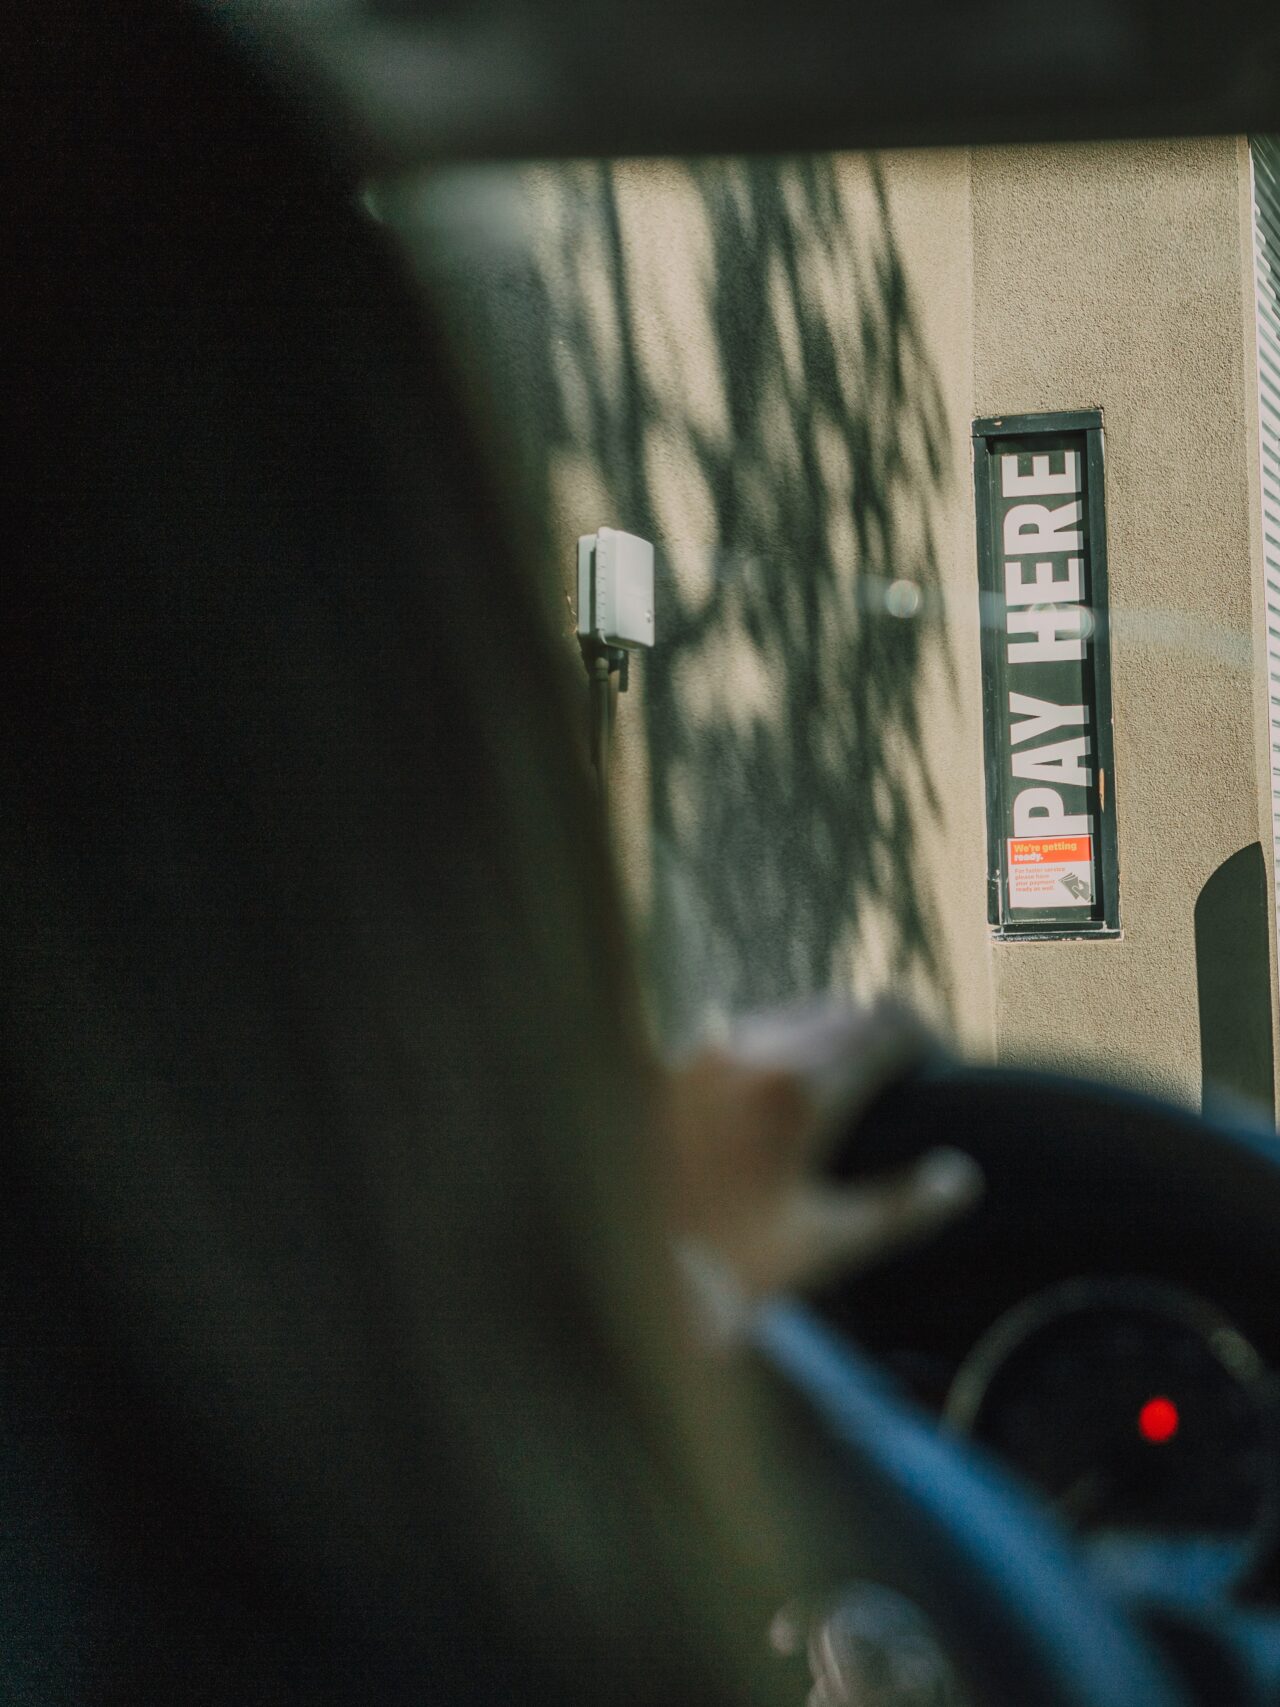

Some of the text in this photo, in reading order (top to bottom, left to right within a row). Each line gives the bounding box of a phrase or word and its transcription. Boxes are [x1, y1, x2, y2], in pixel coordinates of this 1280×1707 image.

[1001, 448, 1088, 664] HERE
[1009, 692, 1093, 838] PAY
[1013, 841, 1077, 853] We're getting
[1013, 852, 1044, 862] ready.
